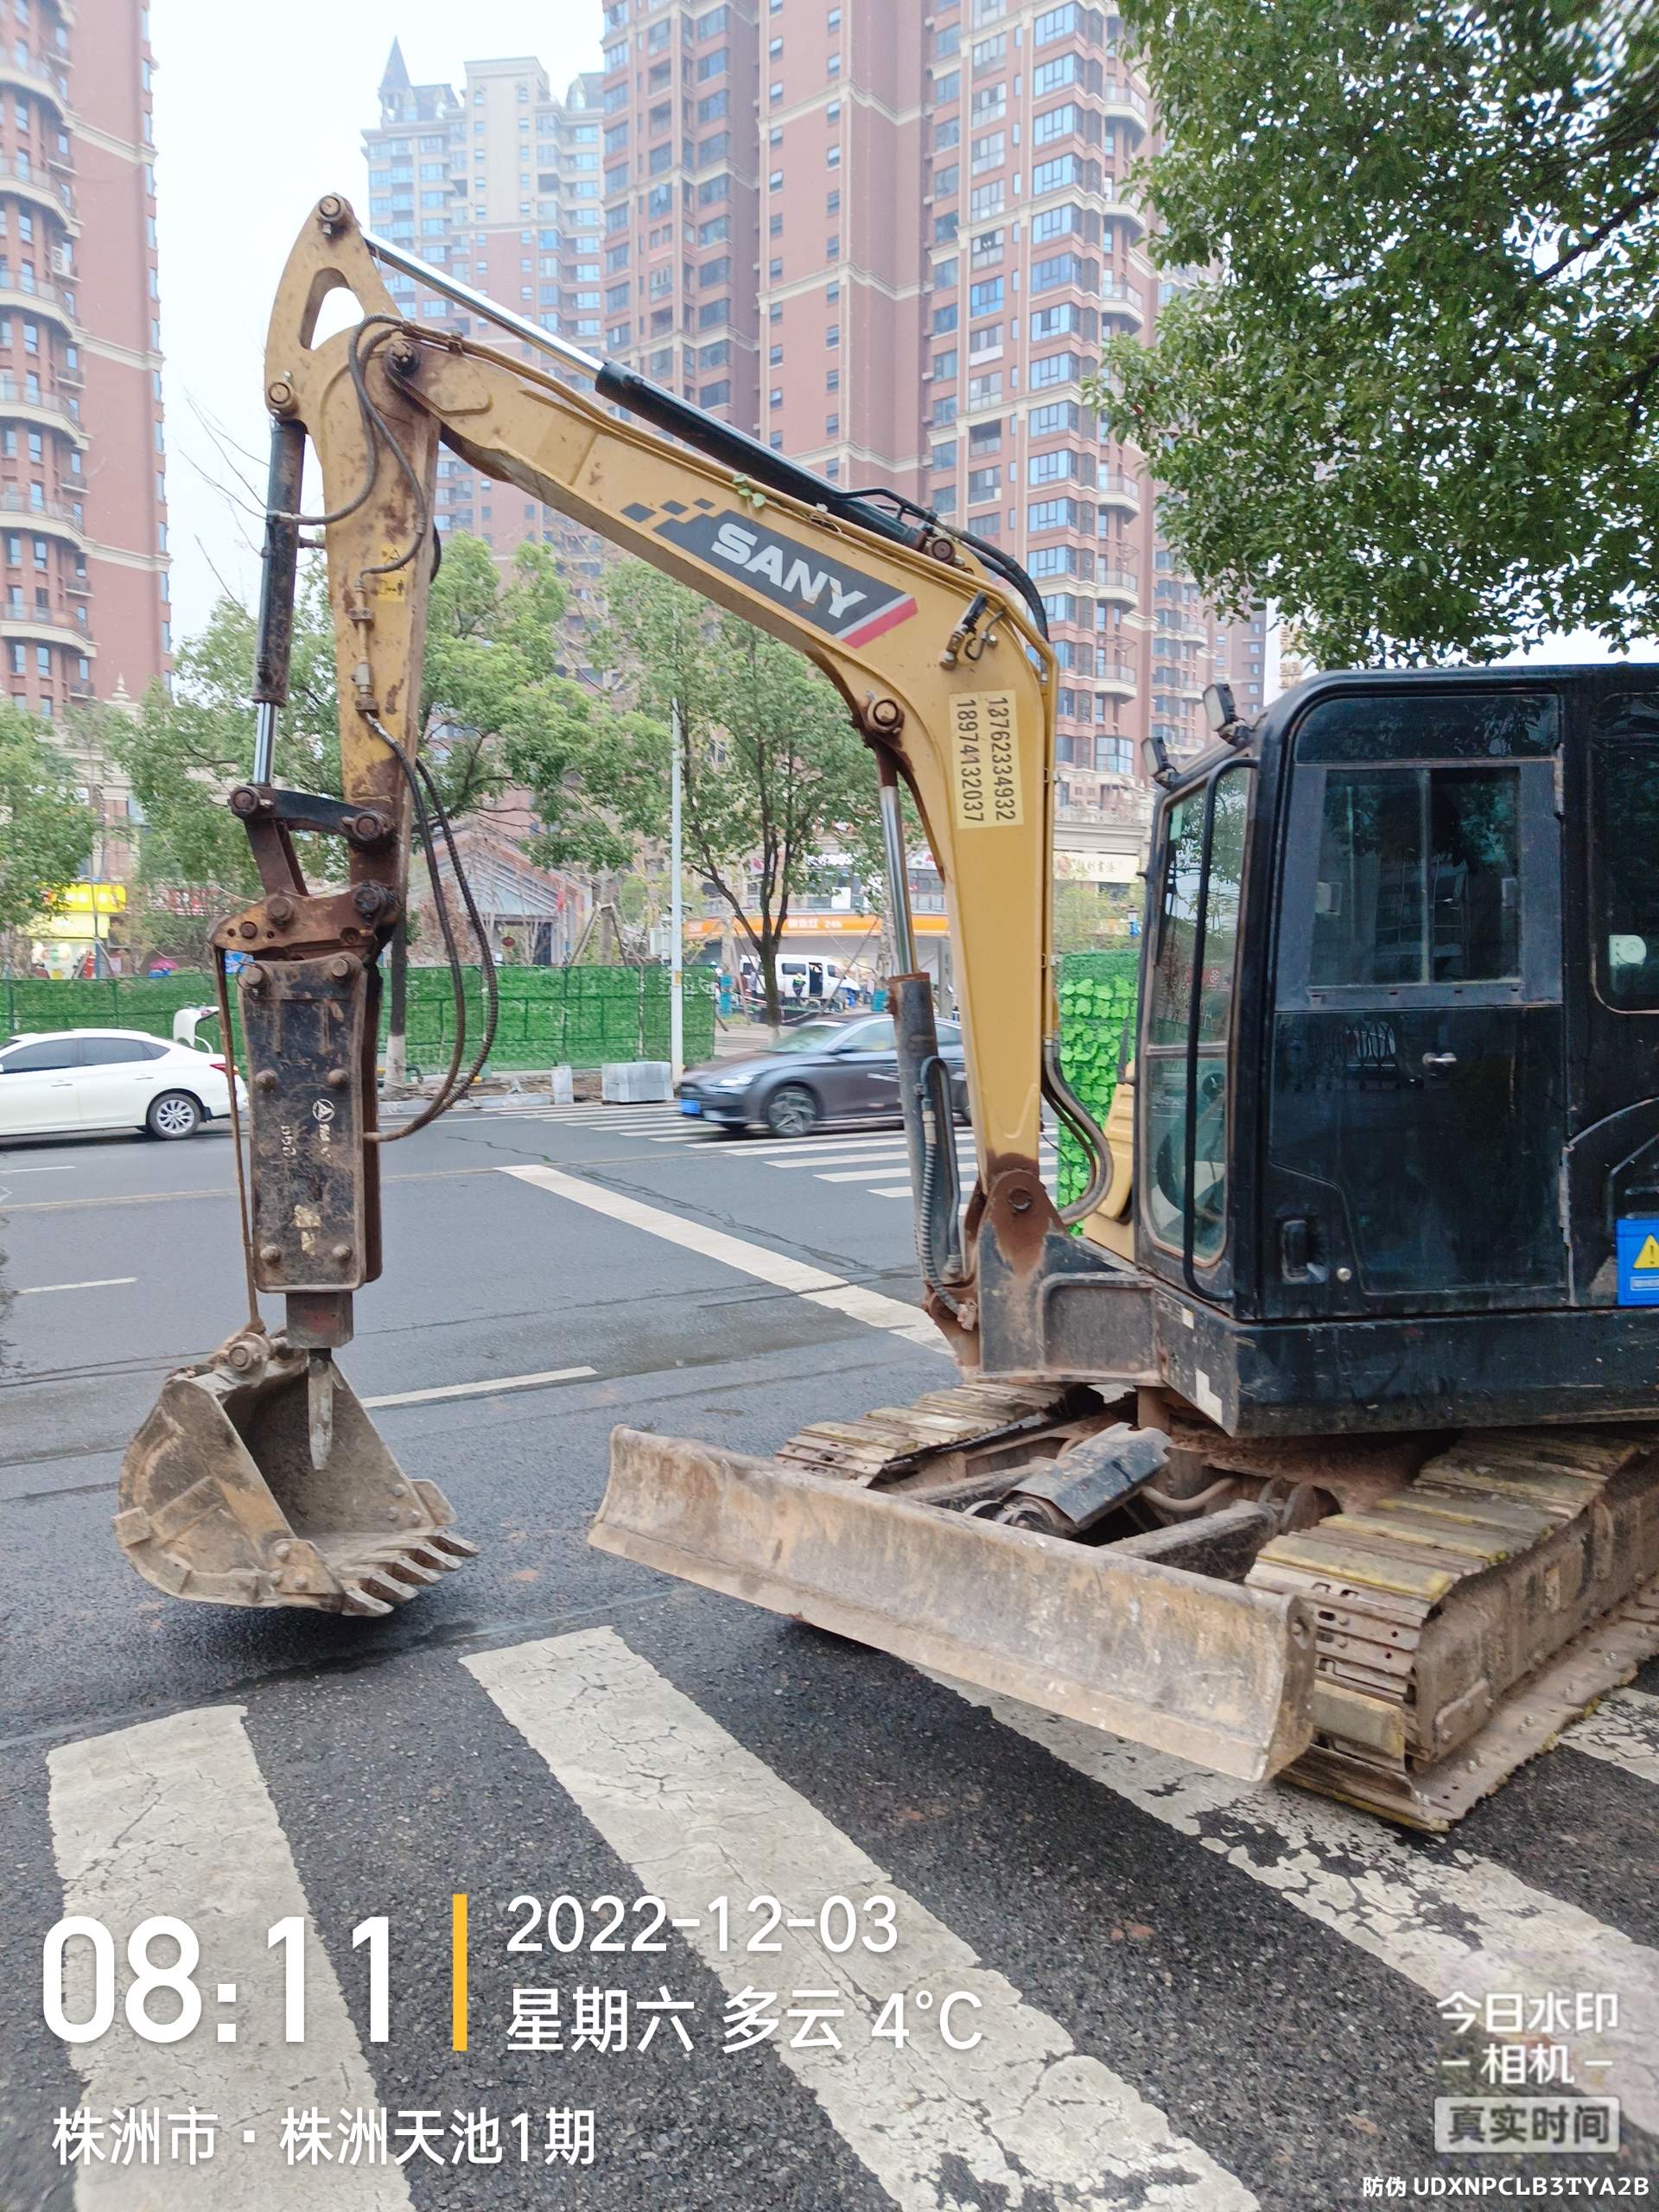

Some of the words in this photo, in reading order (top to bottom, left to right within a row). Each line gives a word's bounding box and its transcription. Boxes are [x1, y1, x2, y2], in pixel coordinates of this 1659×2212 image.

[710, 522, 868, 619] SANY
[957, 699, 984, 822] 18974132037
[988, 696, 1016, 821] 13762334932
